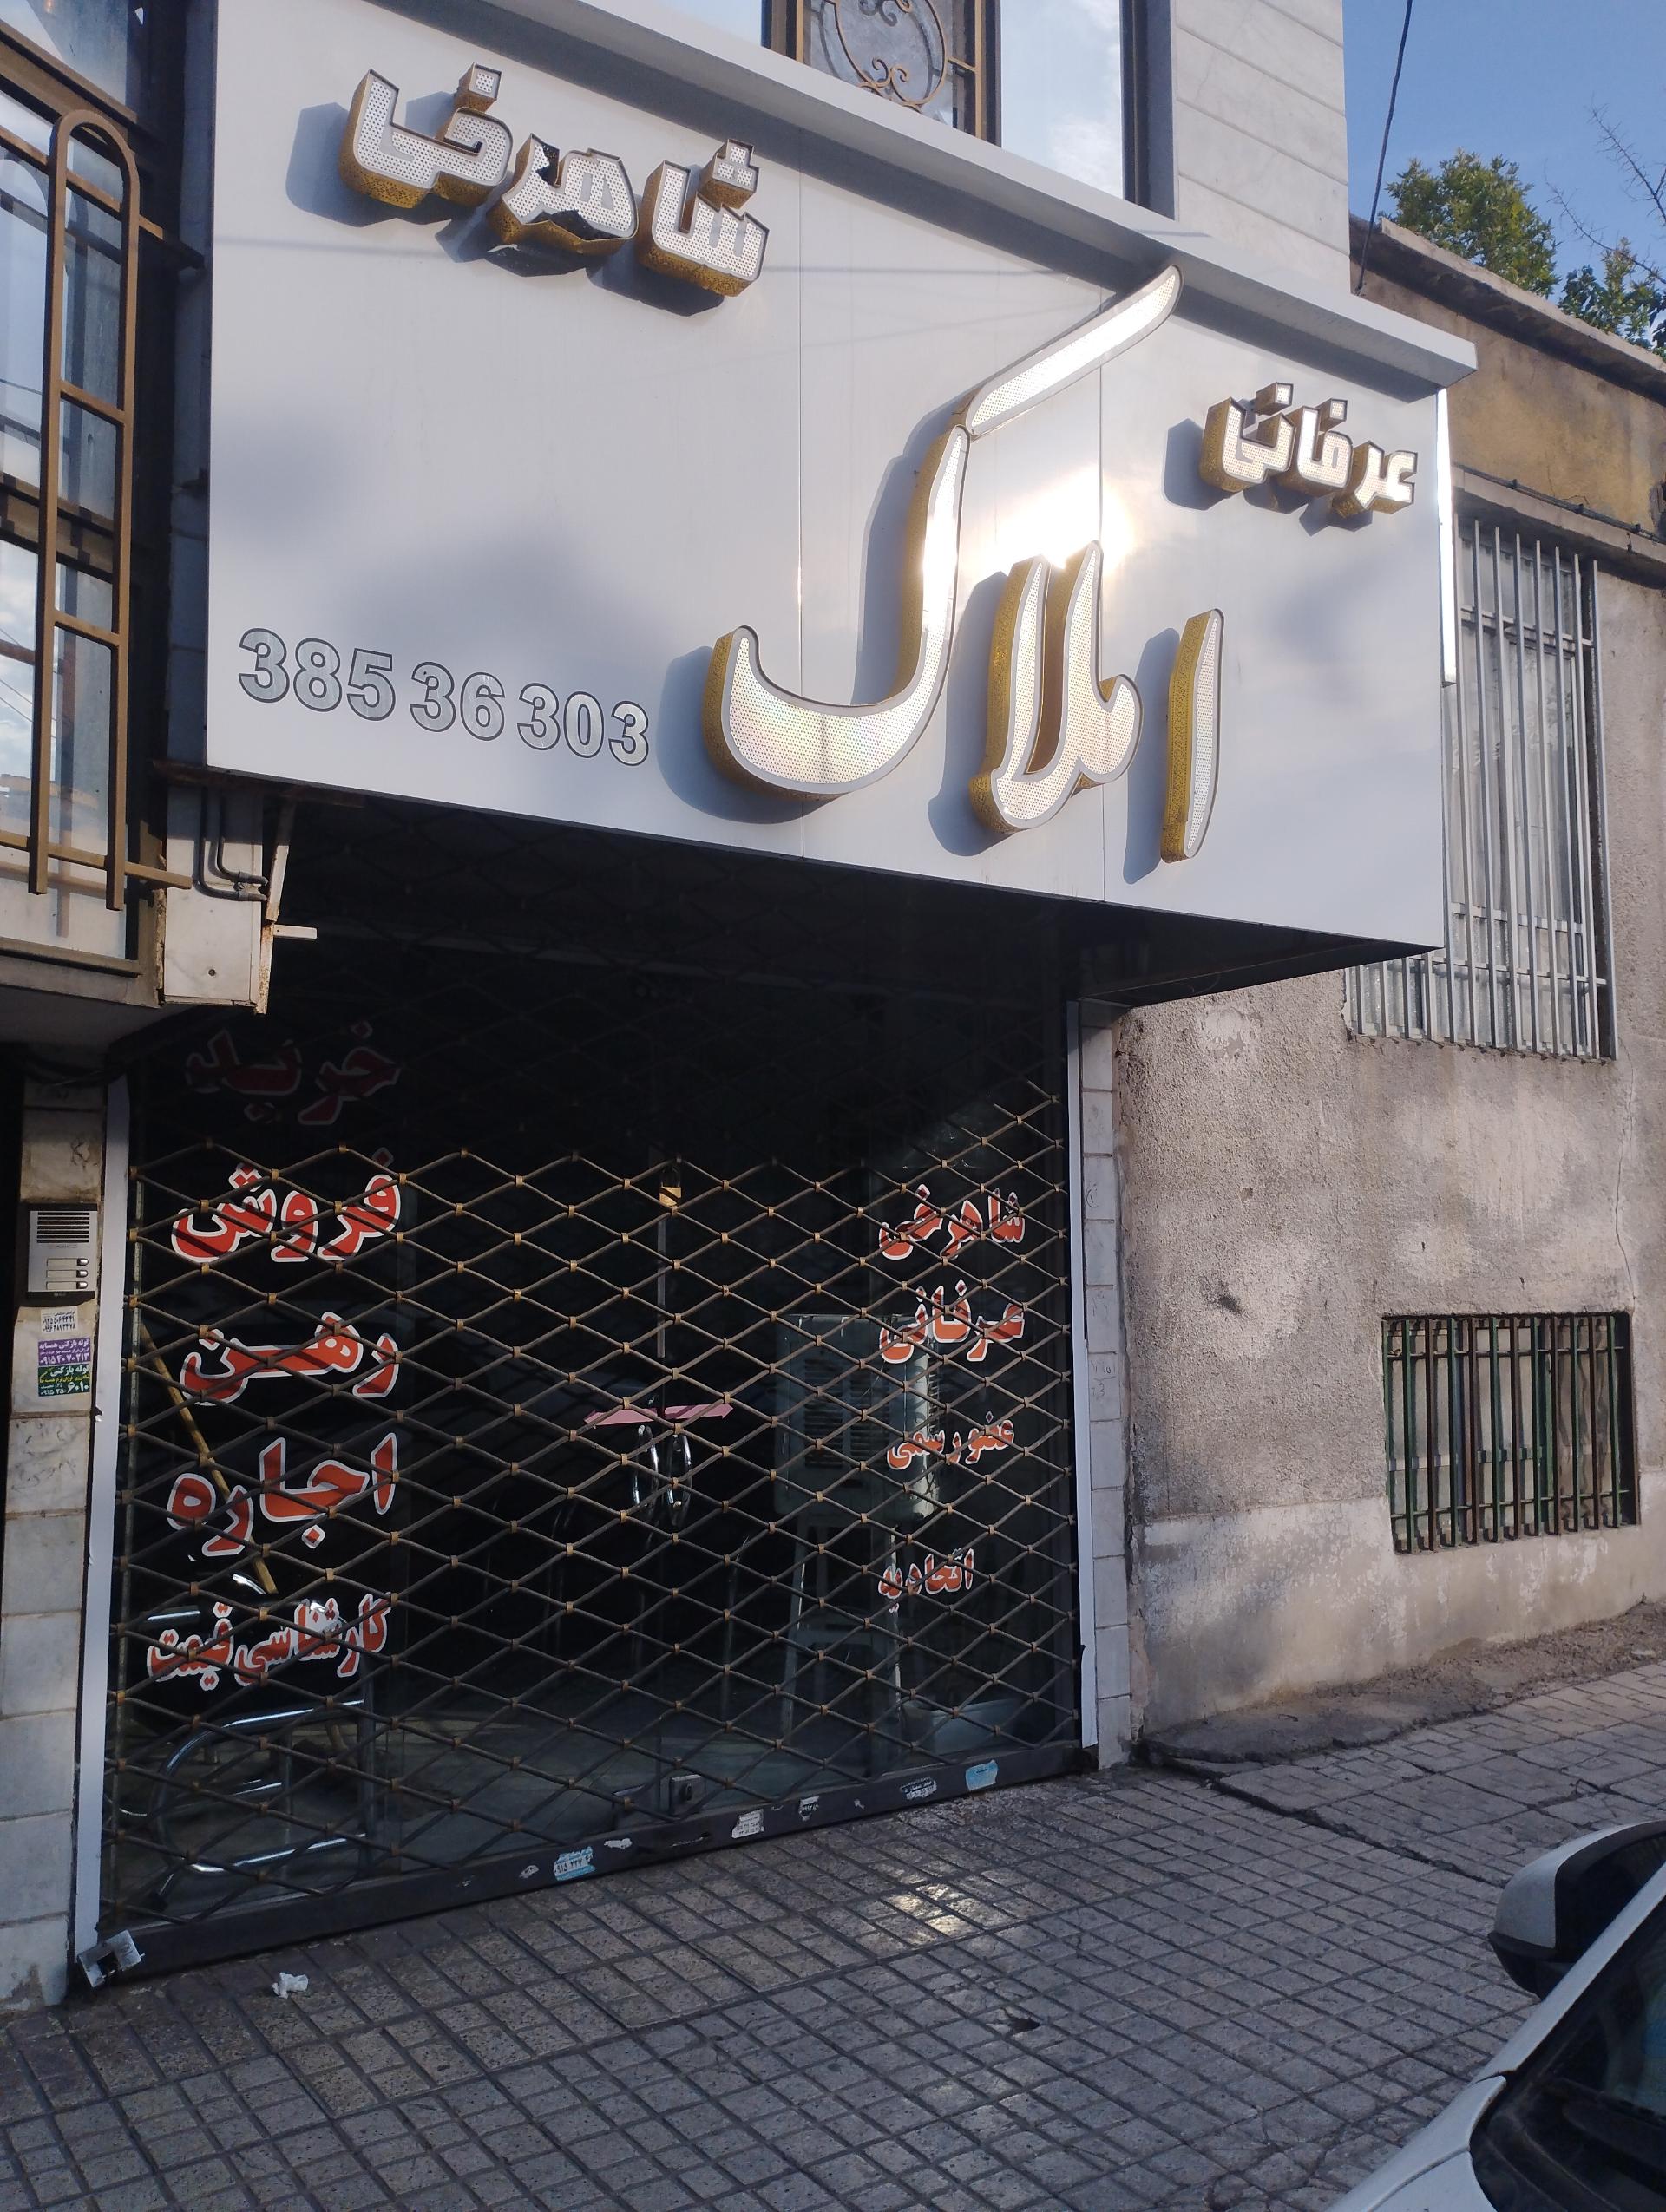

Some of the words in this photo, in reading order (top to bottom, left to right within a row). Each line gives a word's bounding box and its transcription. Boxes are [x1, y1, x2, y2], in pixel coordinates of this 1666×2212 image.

[705, 264, 1225, 863] املاک
[237, 626, 397, 722] 385
[409, 661, 506, 742] 36
[516, 682, 650, 767] 303
[183, 1019, 403, 1127] خرید
[170, 1146, 403, 1264] فروش
[877, 1182, 1026, 1261] شاهرخی
[179, 1310, 400, 1407] رهن
[877, 1279, 1026, 1365] عرفانی
[964, 1410, 1014, 1465] عضو
[166, 1431, 399, 1557] اجاره
[877, 1547, 975, 1615] اتحادیه
[146, 1600, 235, 1692] قیمت
[233, 1593, 393, 1688] کارشناسی
